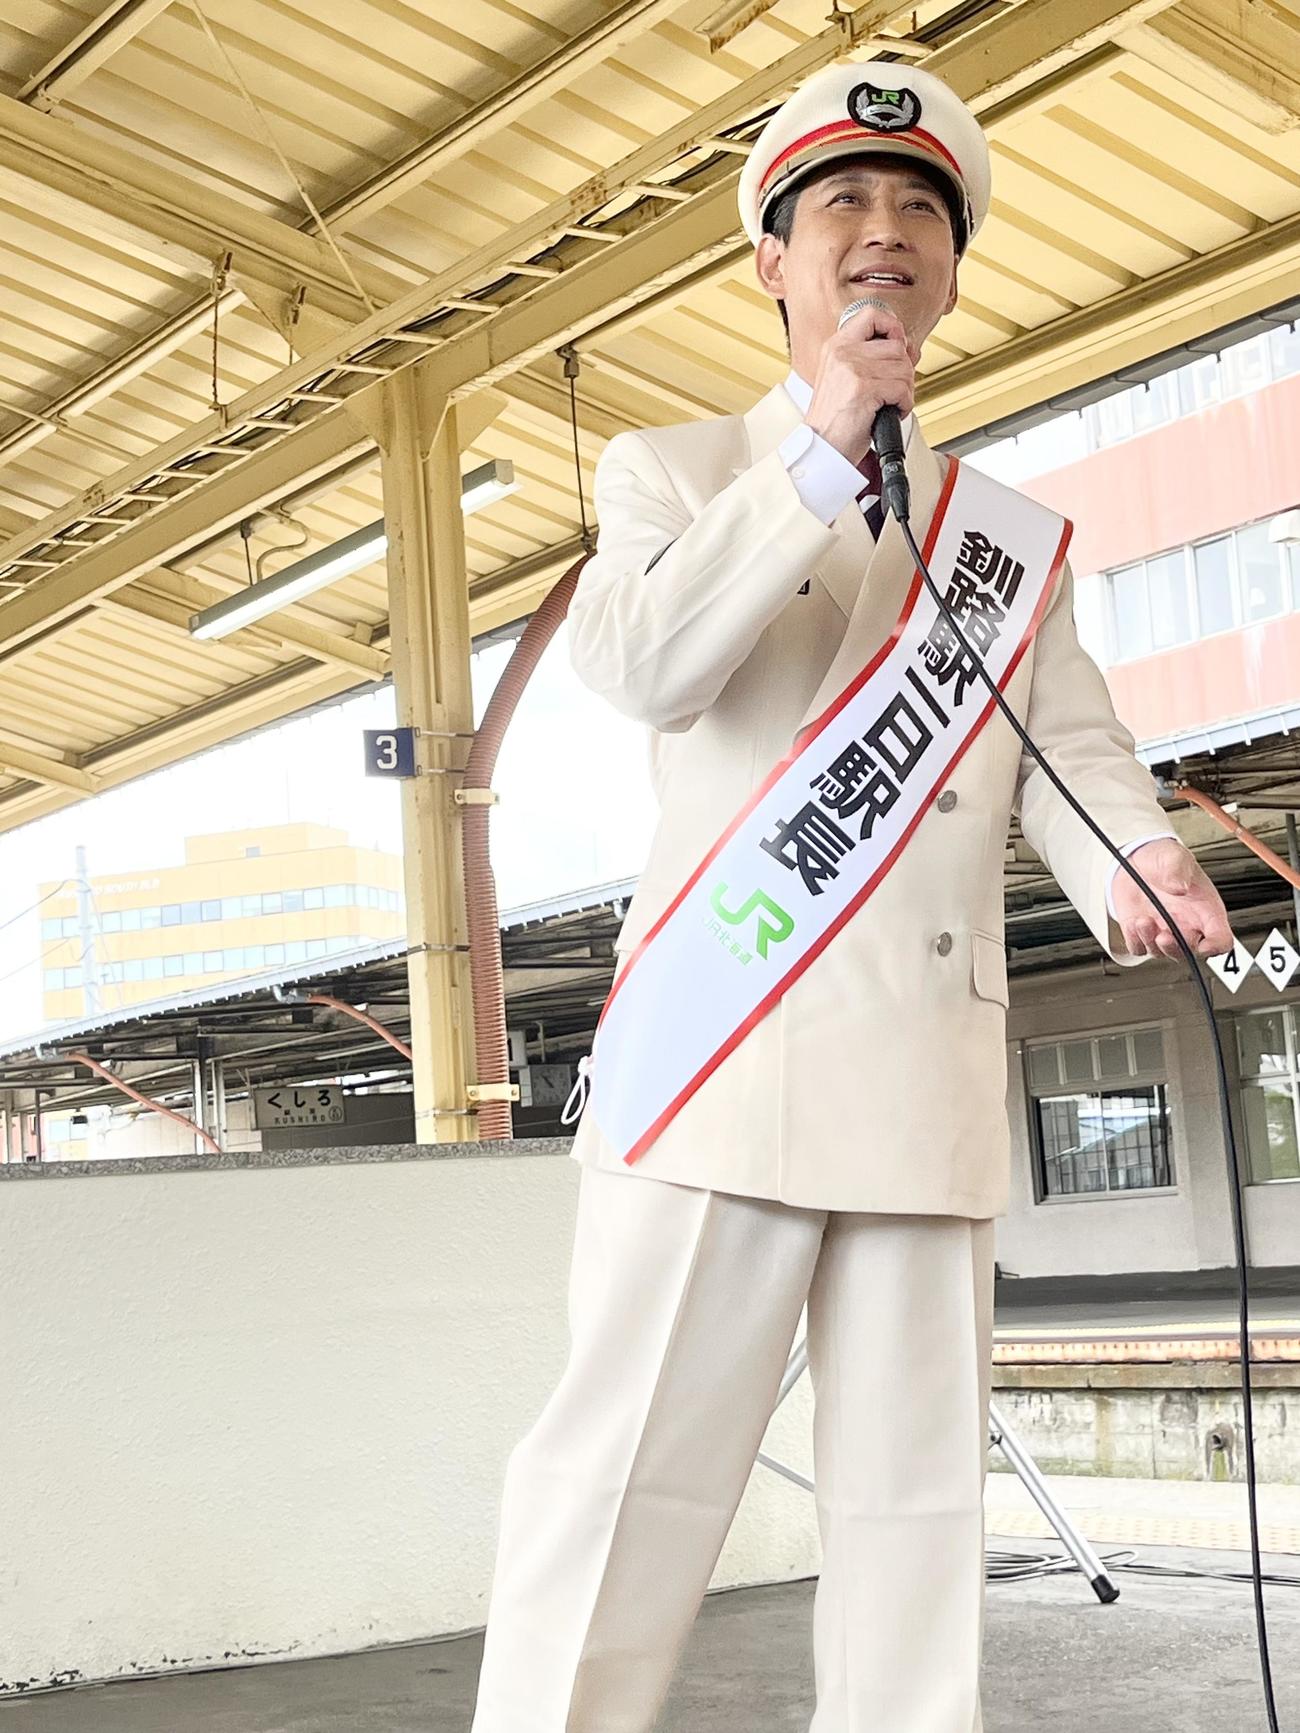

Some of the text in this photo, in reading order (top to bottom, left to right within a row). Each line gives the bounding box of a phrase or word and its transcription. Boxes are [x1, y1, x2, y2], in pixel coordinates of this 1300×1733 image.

[871, 91, 900, 104] JR
[758, 530, 1026, 896] 釧路駅一日駅長
[376, 735, 398, 770] 3
[710, 881, 795, 961] JR
[1223, 947, 1240, 975] 4
[1270, 946, 1286, 973] 5
[267, 1089, 331, 1109] くしろ
[274, 1114, 326, 1125] KUSHIRO
